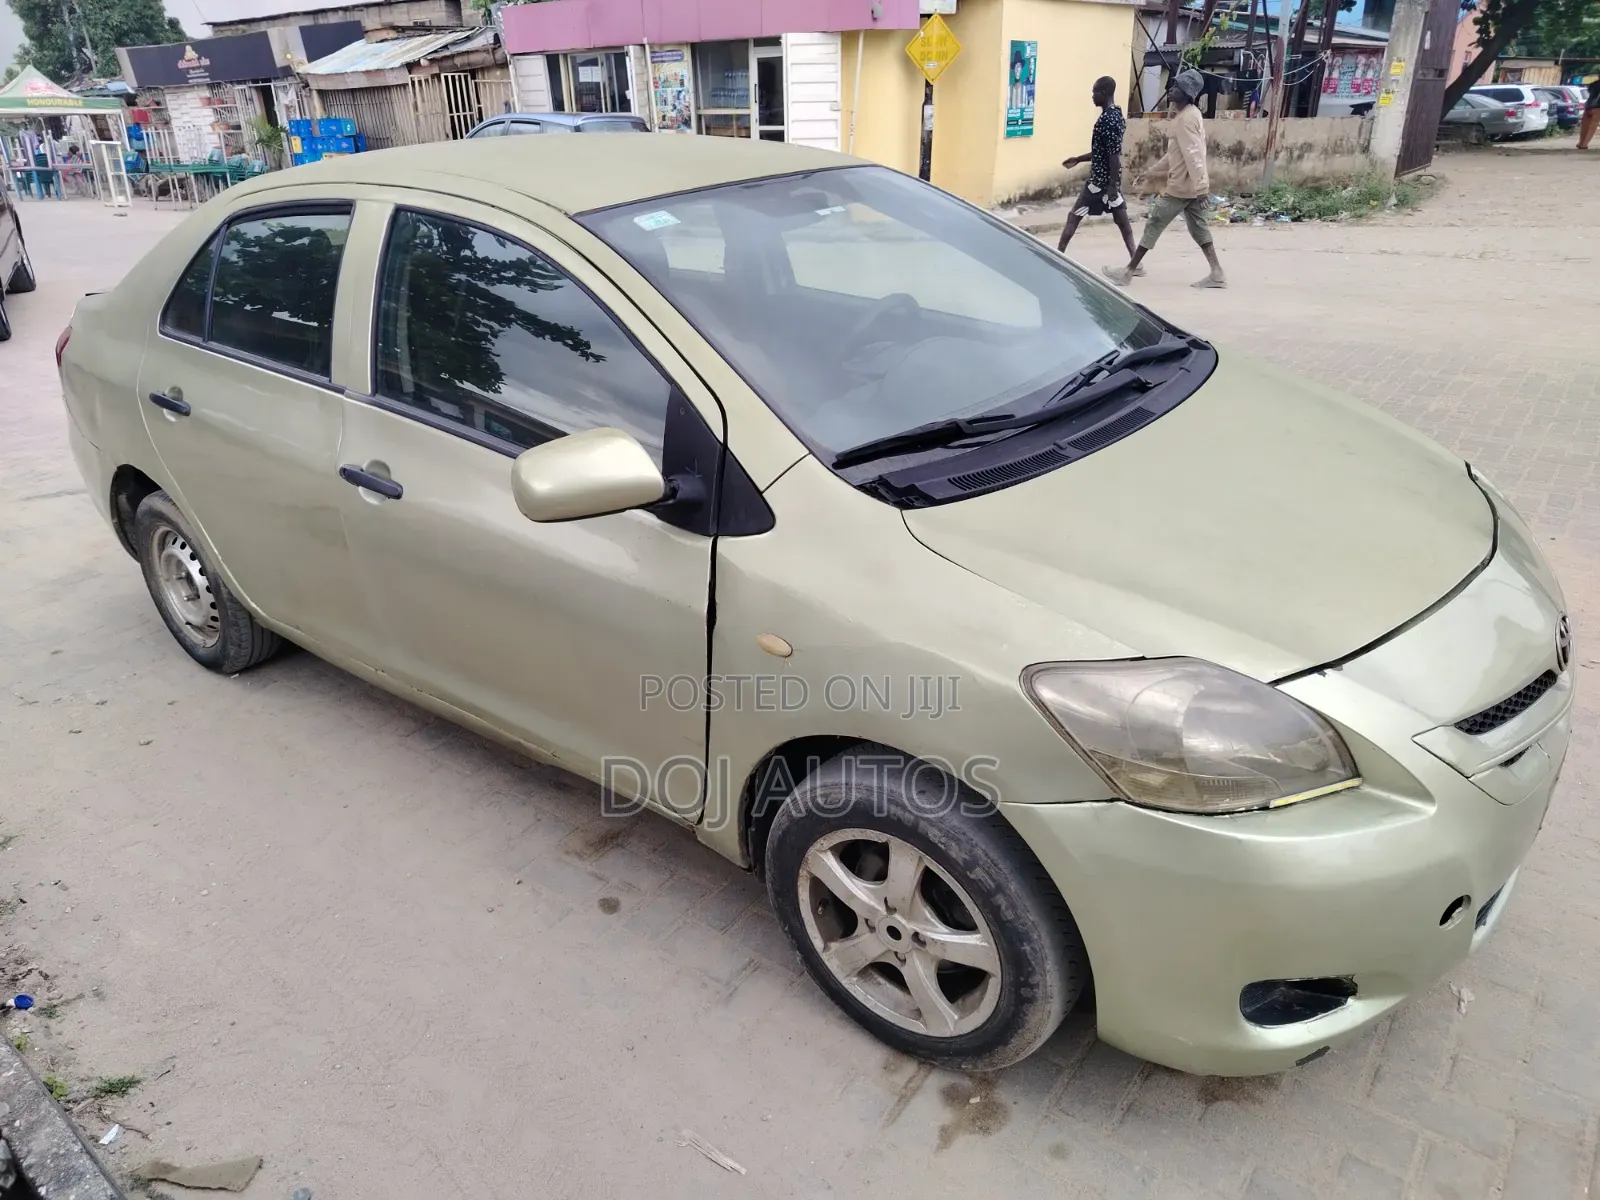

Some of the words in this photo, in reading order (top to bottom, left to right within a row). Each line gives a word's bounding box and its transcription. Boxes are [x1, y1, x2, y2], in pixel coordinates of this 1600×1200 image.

[920, 36, 948, 47] SLOW
[920, 51, 948, 61] DOWN
[26, 98, 84, 107] HONOURABLE
